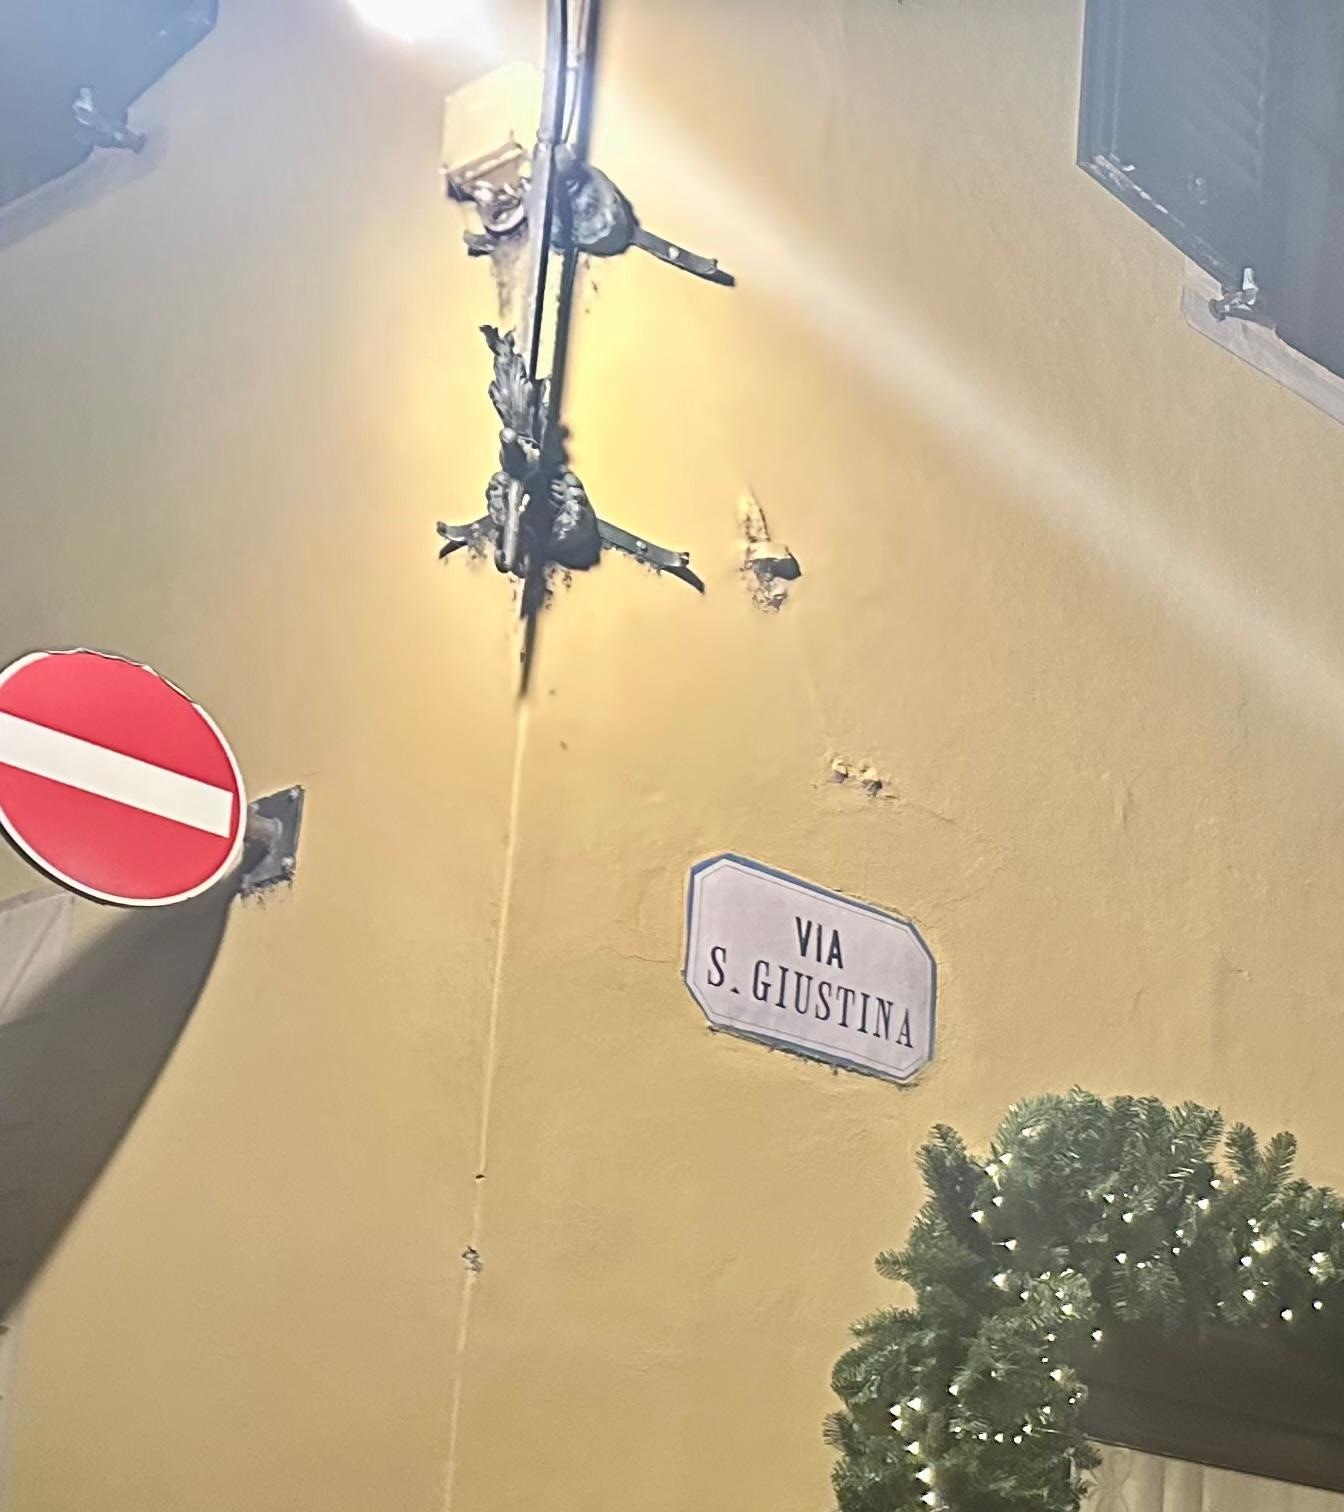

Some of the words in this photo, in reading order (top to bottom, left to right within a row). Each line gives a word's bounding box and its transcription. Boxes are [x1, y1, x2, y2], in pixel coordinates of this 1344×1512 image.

[795, 916, 844, 969] VIA
[707, 946, 740, 994] S.
[752, 959, 914, 1049] GIUSTINA
